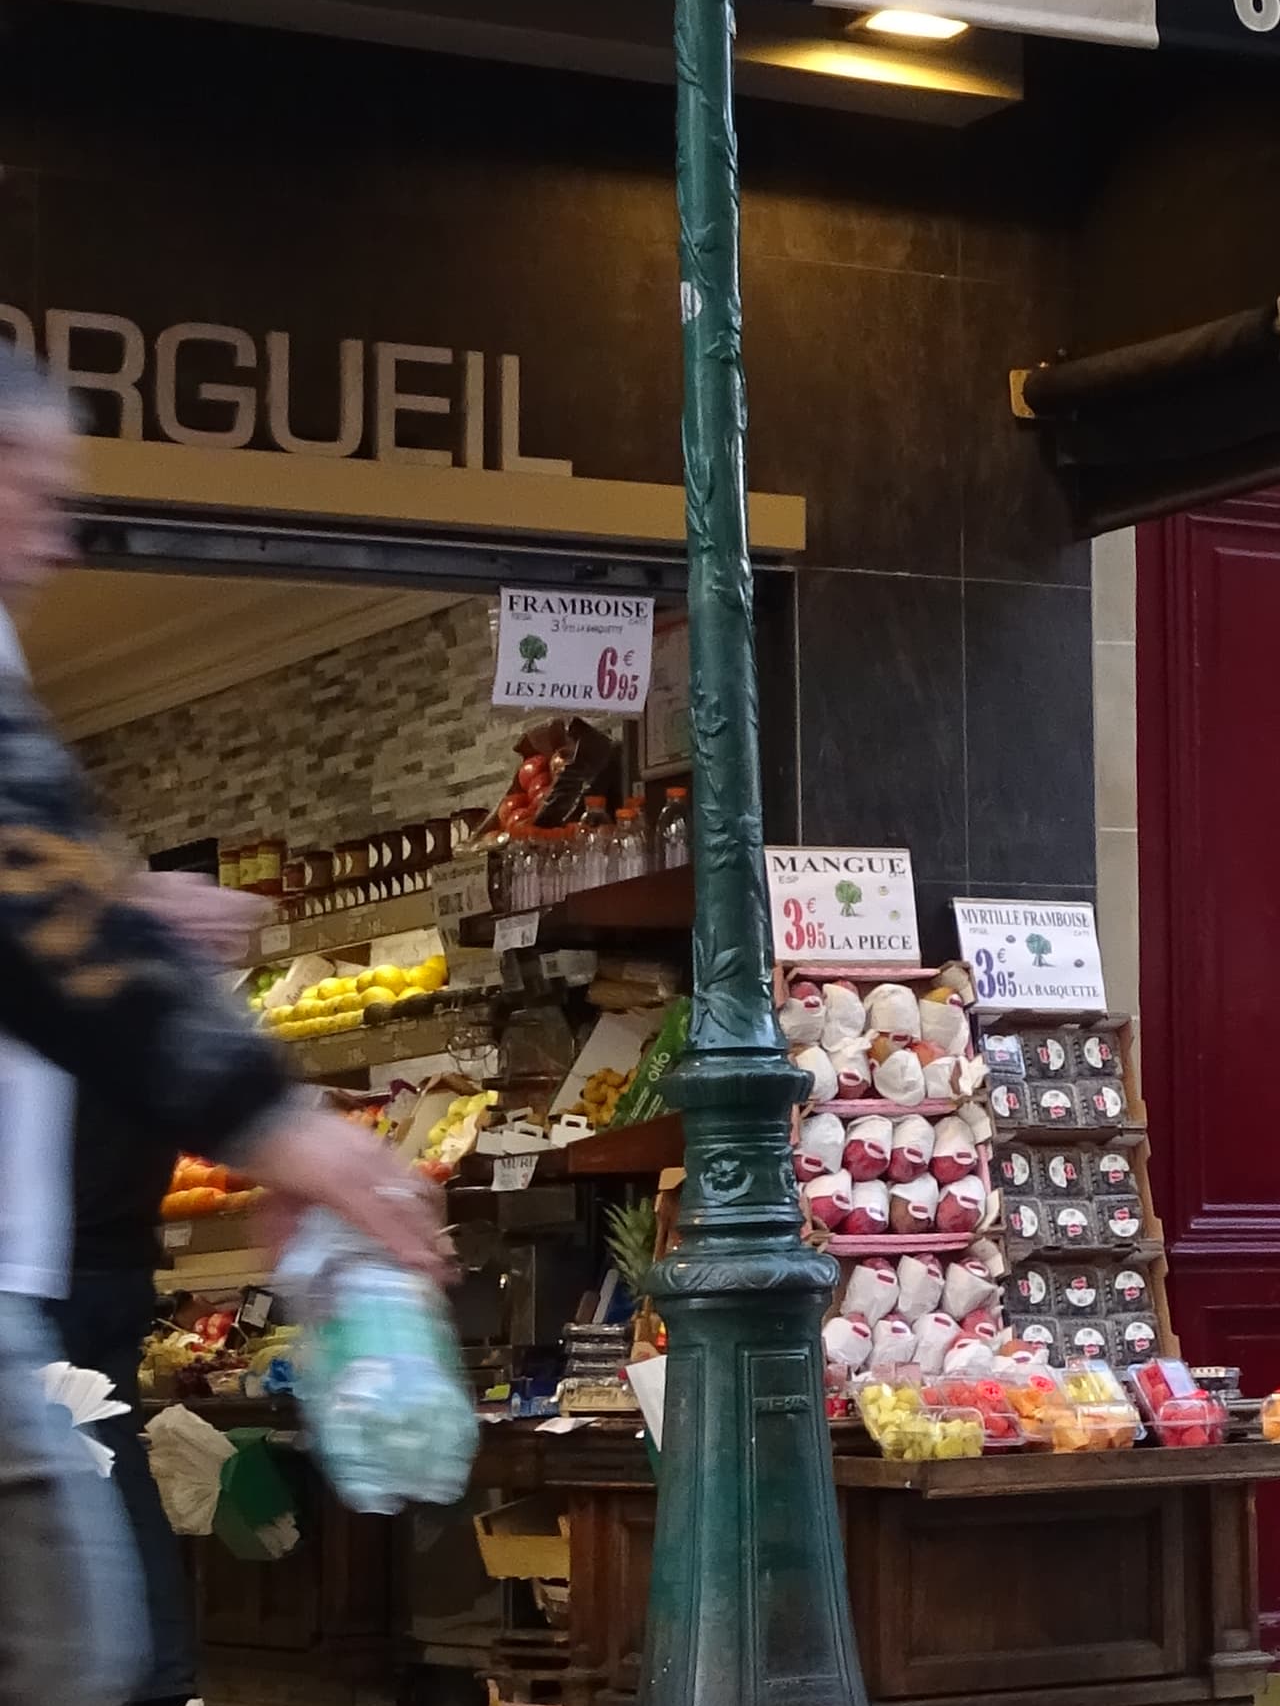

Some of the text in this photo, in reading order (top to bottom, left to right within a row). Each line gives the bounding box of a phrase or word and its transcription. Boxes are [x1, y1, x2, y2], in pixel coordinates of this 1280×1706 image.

[508, 595, 649, 618] FRAMBOISE
[505, 681, 536, 697] LES
[539, 682, 547, 697] 2
[550, 683, 594, 700] POUR
[772, 856, 907, 875] MANGUE
[961, 908, 1090, 929] MYRTILLE FRAMBOISE
[829, 935, 854, 951] LA
[858, 935, 913, 951] PIECE
[1018, 984, 1034, 997] LA
[1034, 985, 1100, 1000] BARQUETTE
